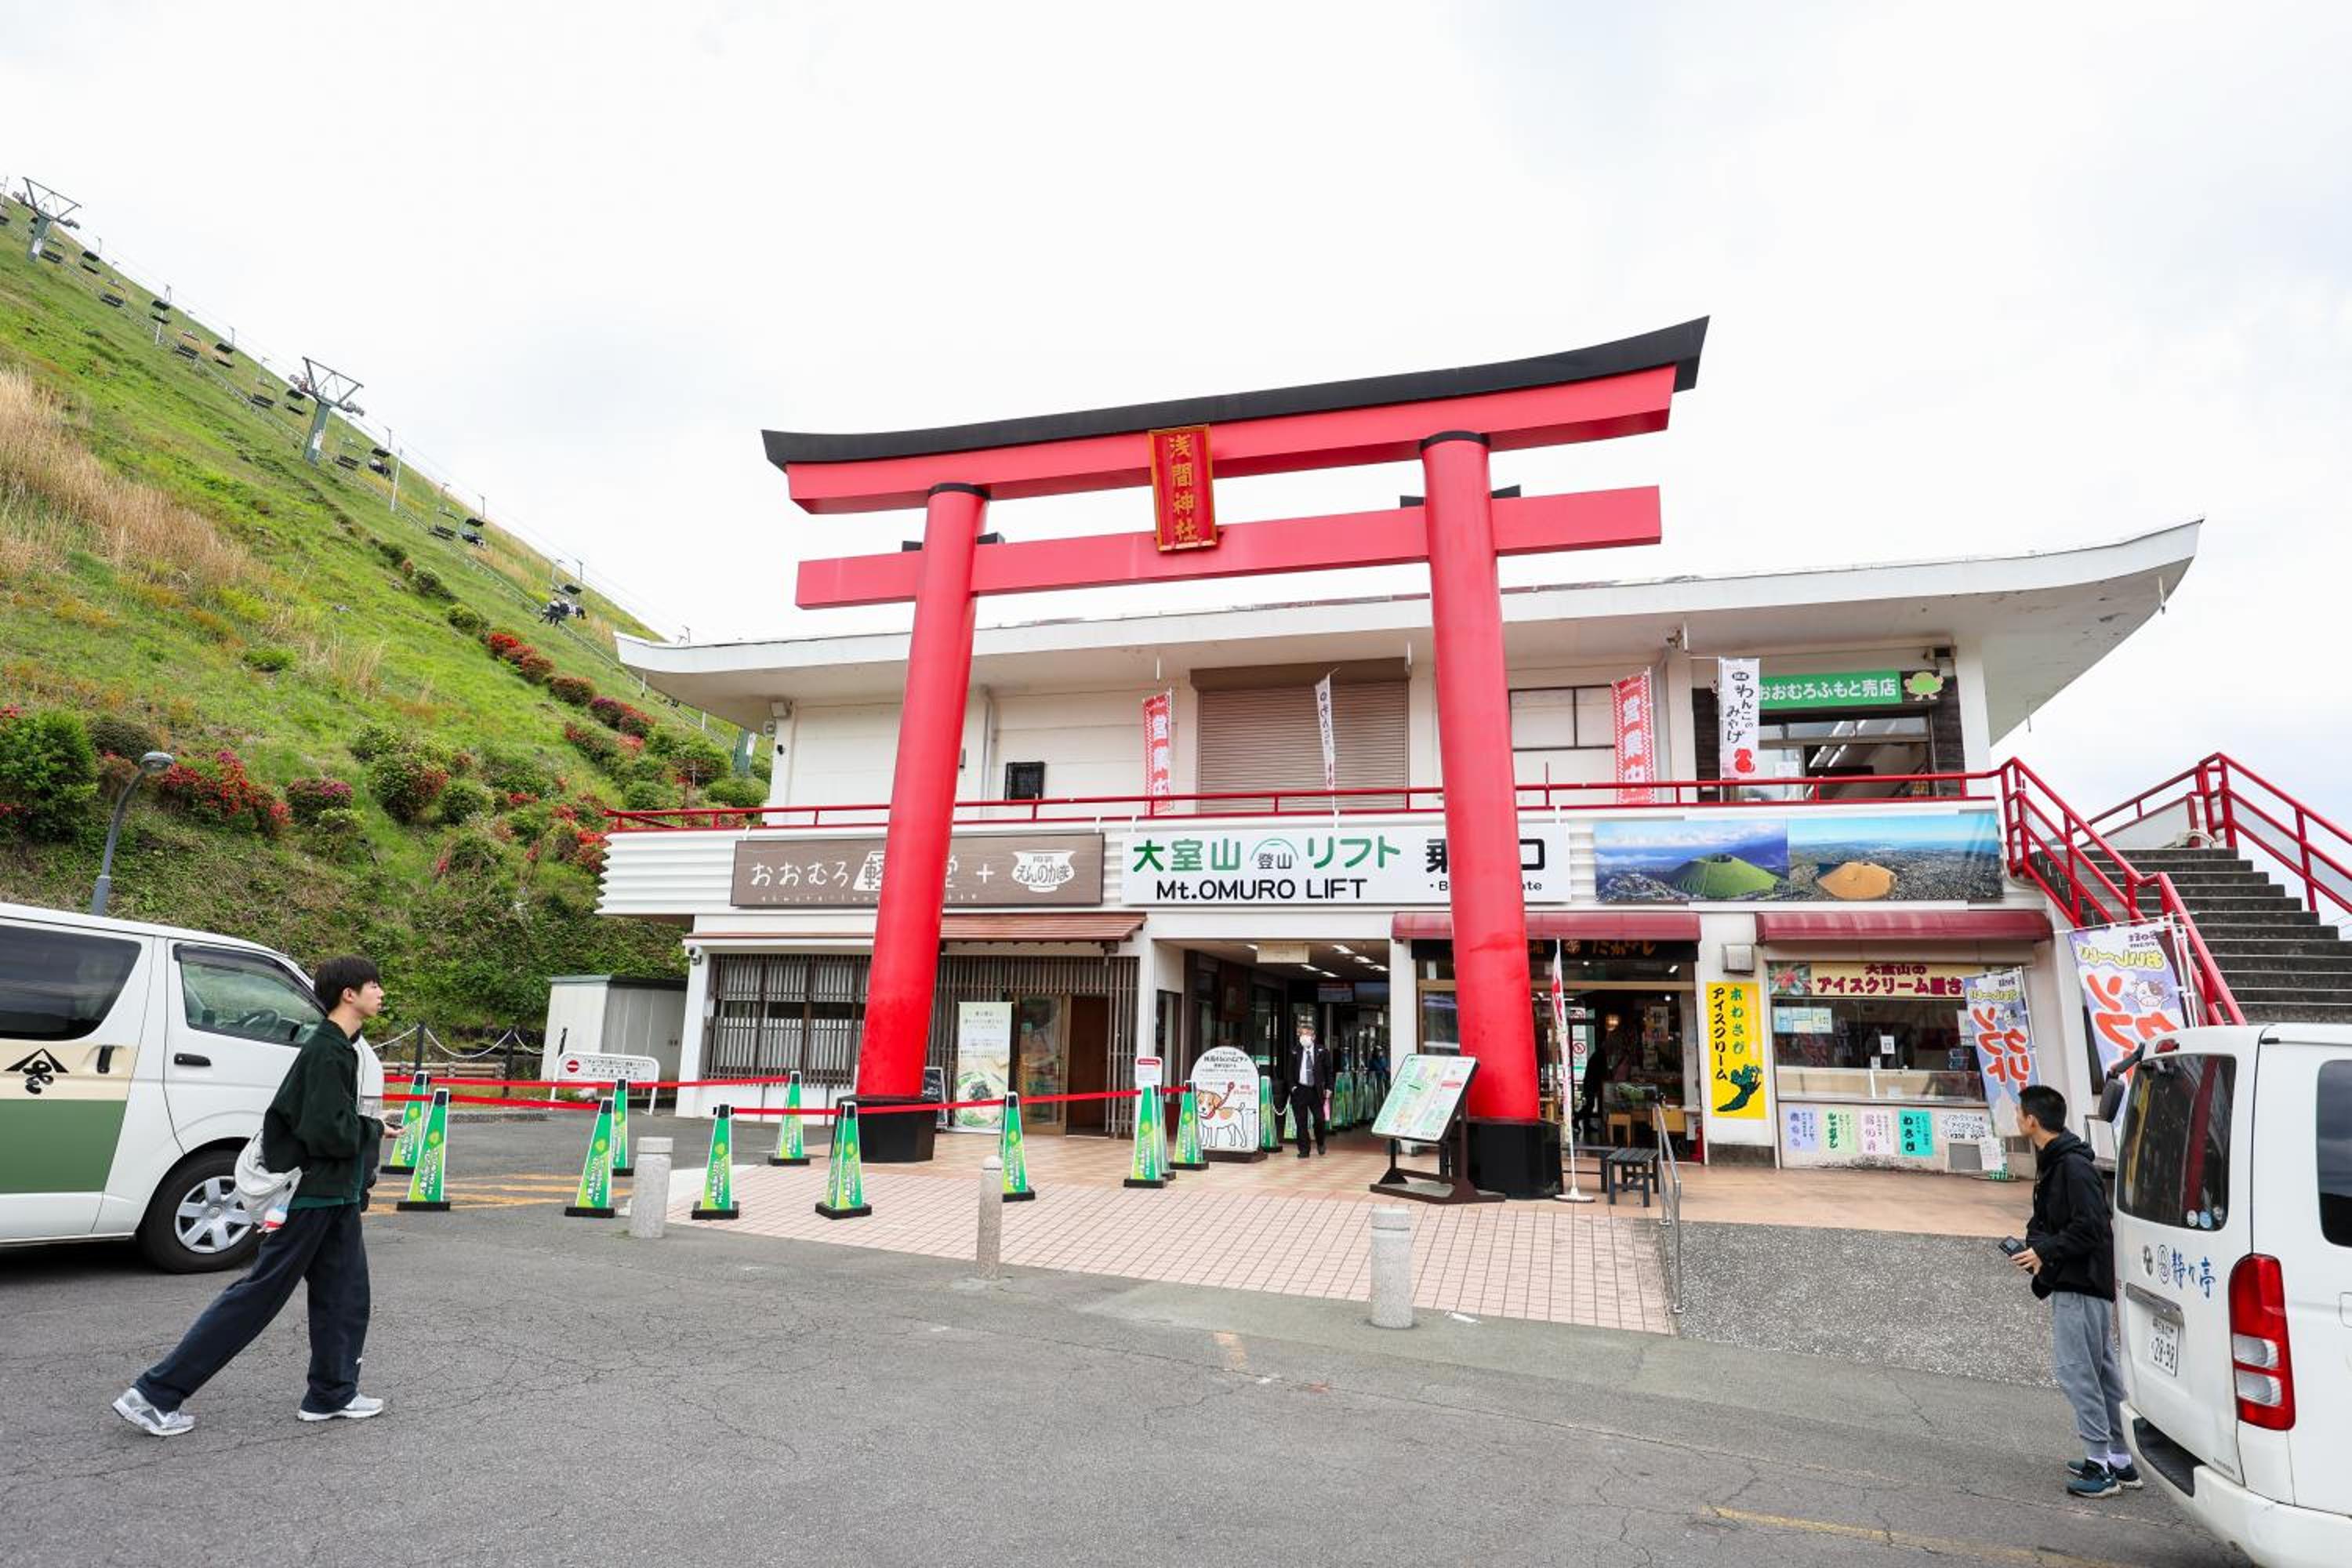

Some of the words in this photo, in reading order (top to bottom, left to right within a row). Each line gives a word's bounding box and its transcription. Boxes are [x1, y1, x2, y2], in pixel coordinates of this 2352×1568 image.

[1169, 434, 1198, 541] 浅間神社
[1759, 679, 1896, 700] おおむろふもと売店
[1133, 839, 1241, 872] 大室山
[1257, 853, 1293, 869] 登山
[1307, 836, 1401, 869] リフト
[1425, 839, 1545, 873] 乗口
[1156, 879, 1296, 900] Mt.OMURO
[1307, 878, 1368, 899] LIFT
[1864, 964, 1926, 975] 大室山の
[1817, 977, 1962, 995] アイスクリーム屋さ
[1713, 987, 1728, 1080] アイスクリーム
